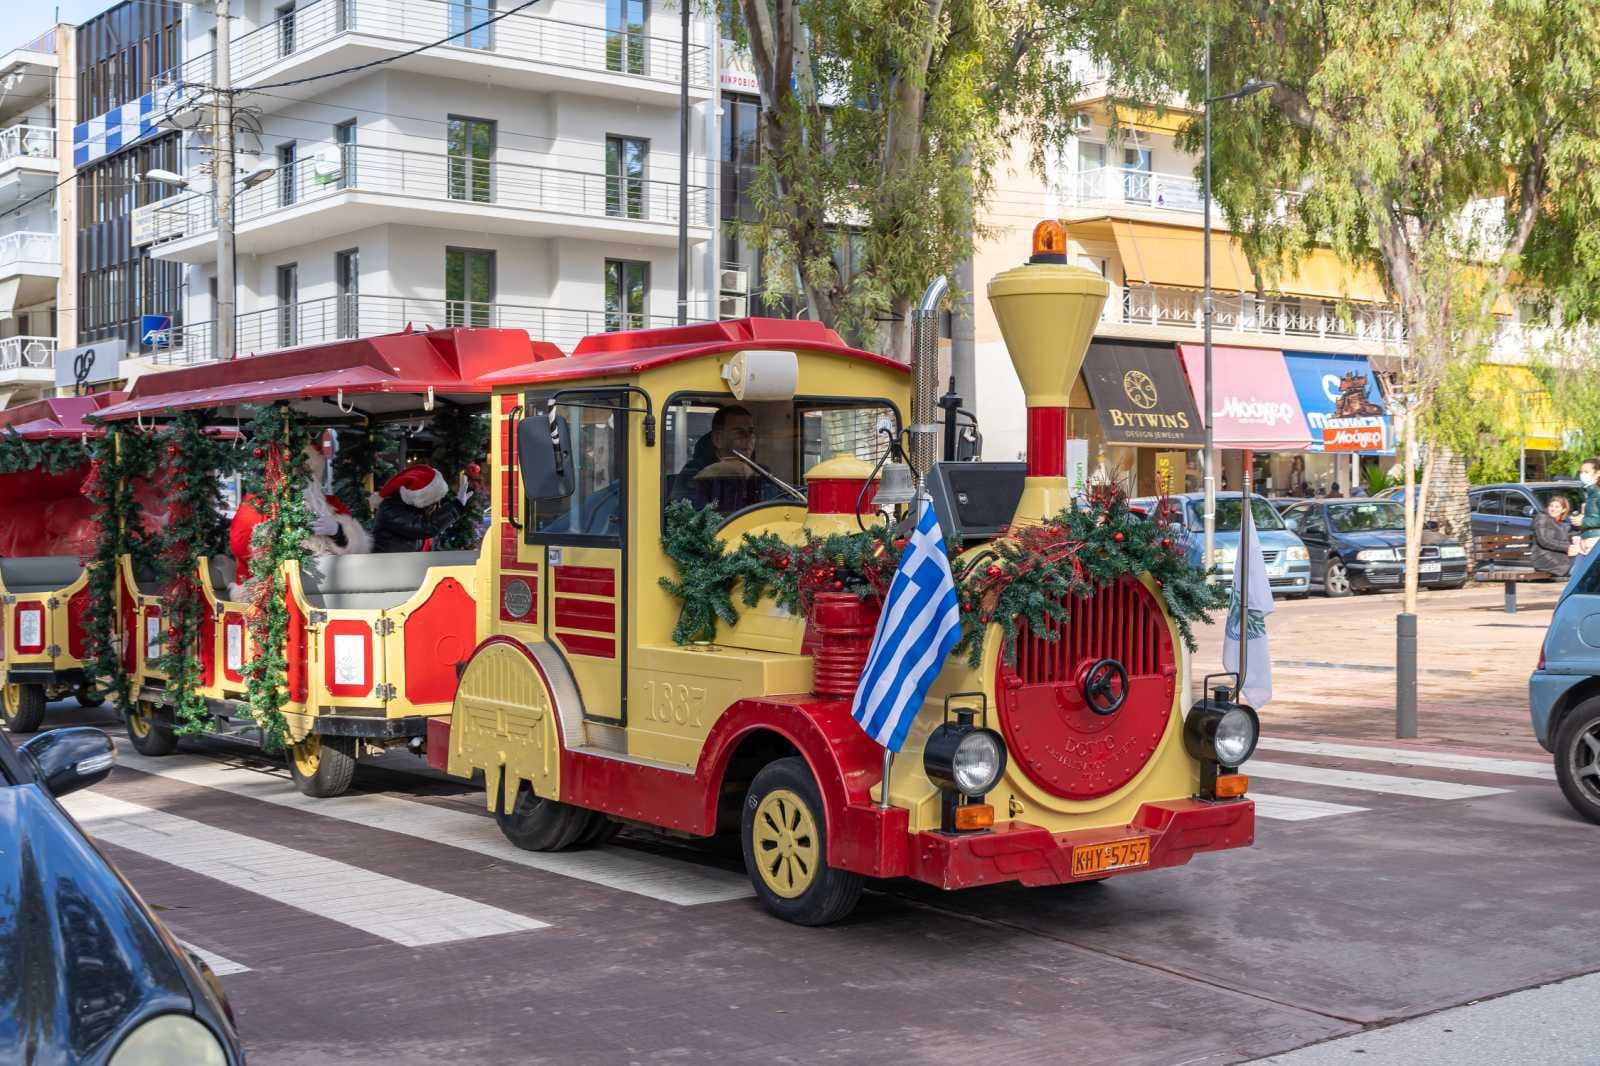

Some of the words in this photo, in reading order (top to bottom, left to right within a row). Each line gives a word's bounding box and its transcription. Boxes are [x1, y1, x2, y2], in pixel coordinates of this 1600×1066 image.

[1109, 409, 1189, 429] BYTWINS
[1124, 430, 1152, 438] DESIGN
[644, 680, 707, 728] 1887
